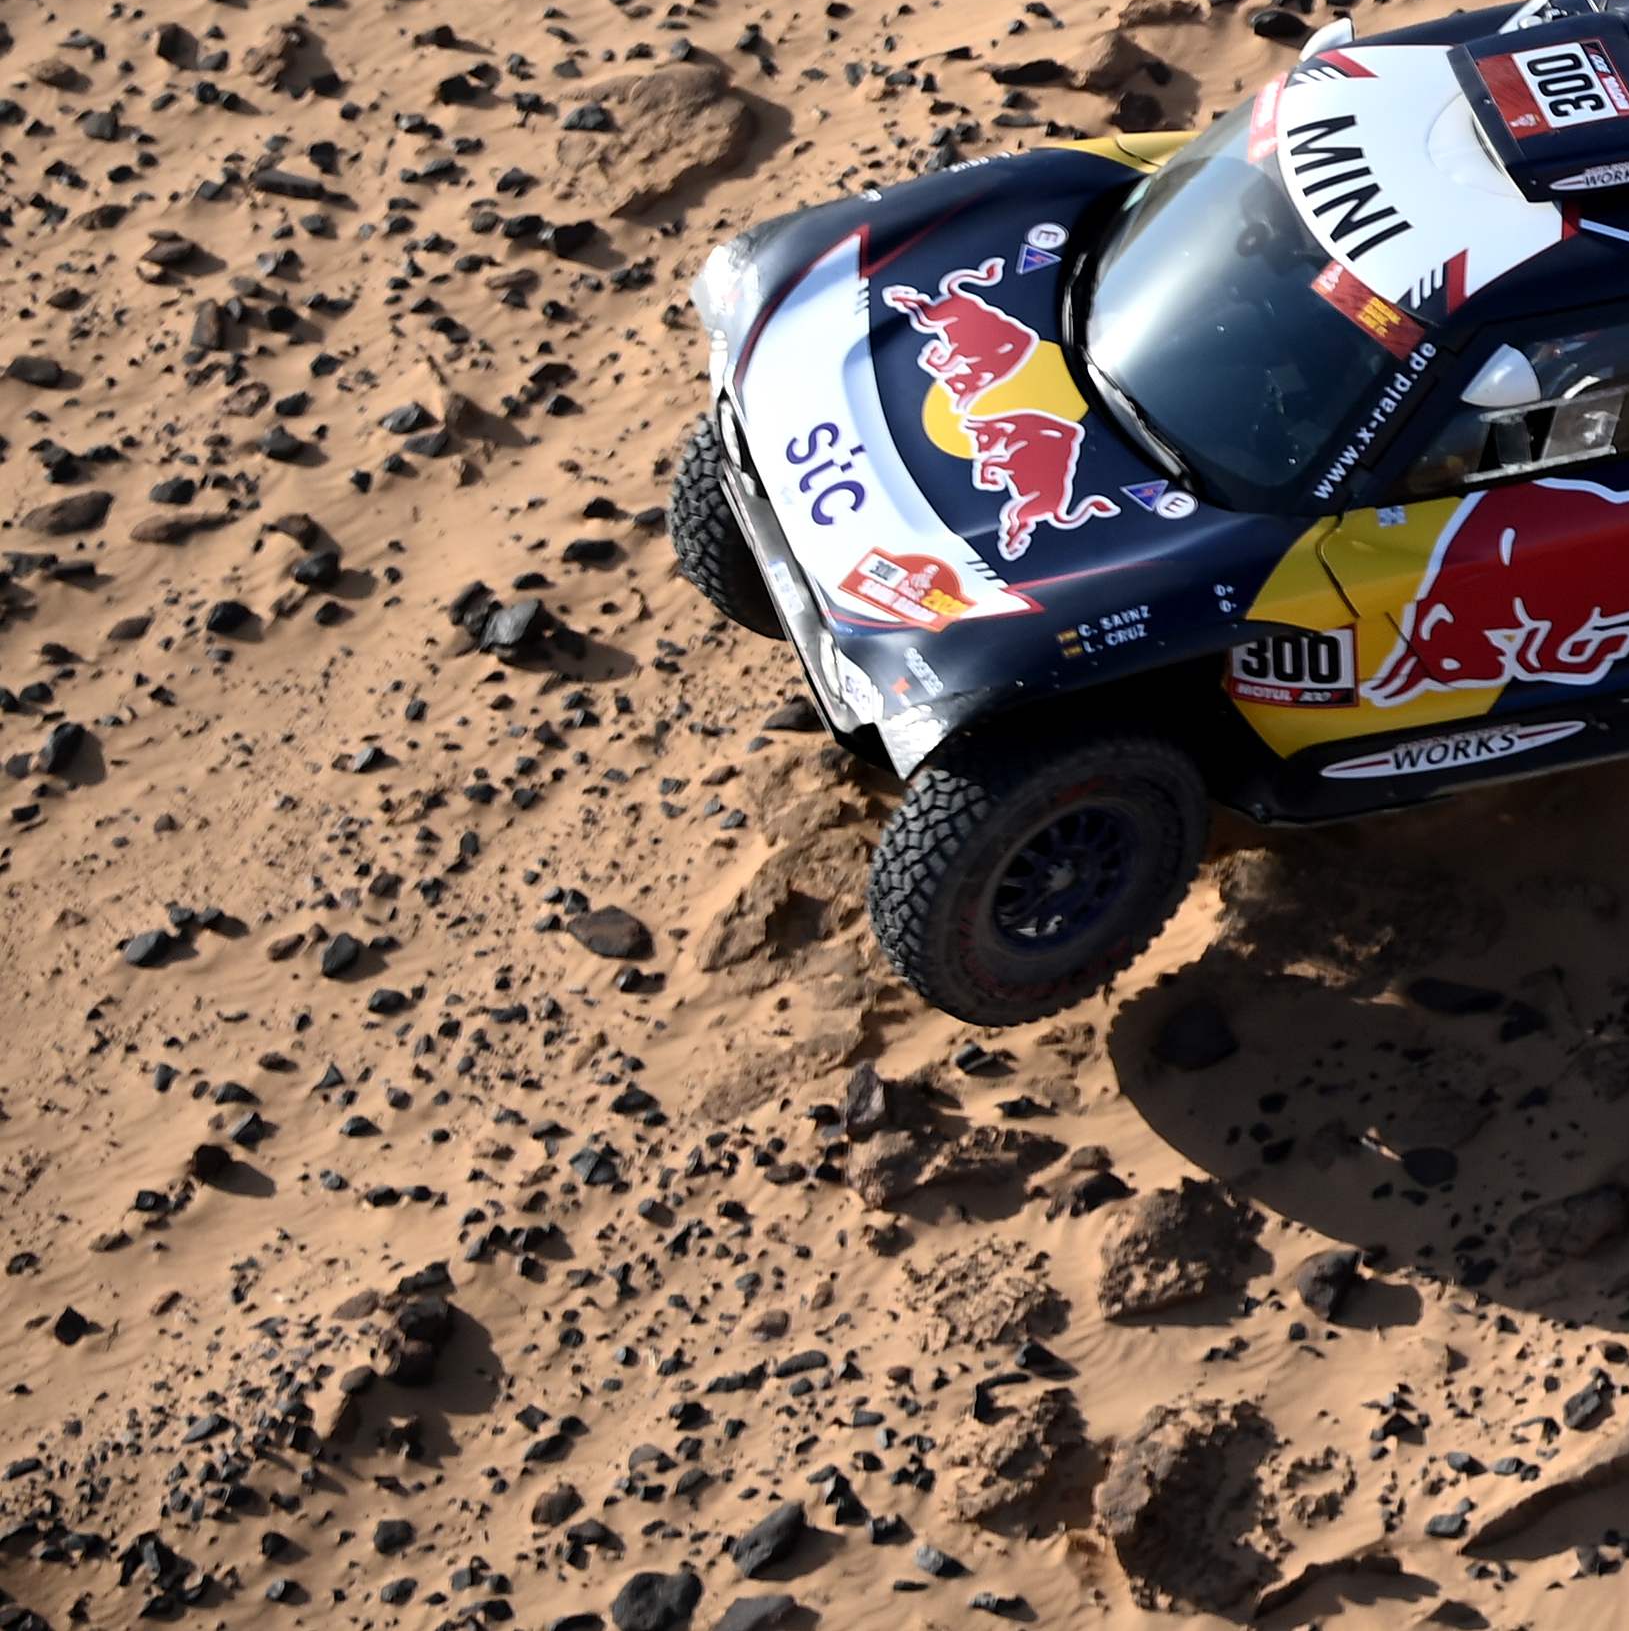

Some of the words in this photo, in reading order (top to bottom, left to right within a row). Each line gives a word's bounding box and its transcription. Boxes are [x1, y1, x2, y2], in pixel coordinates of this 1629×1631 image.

[1527, 52, 1605, 117] 300
[1287, 114, 1414, 262] MINI
[1313, 341, 1437, 500] www.x-raid.de
[786, 422, 866, 525] stc
[1099, 604, 1151, 630] SAINZ
[1104, 623, 1148, 646] CRUZ
[1241, 633, 1342, 685] 300
[1391, 729, 1519, 770] WORKS
